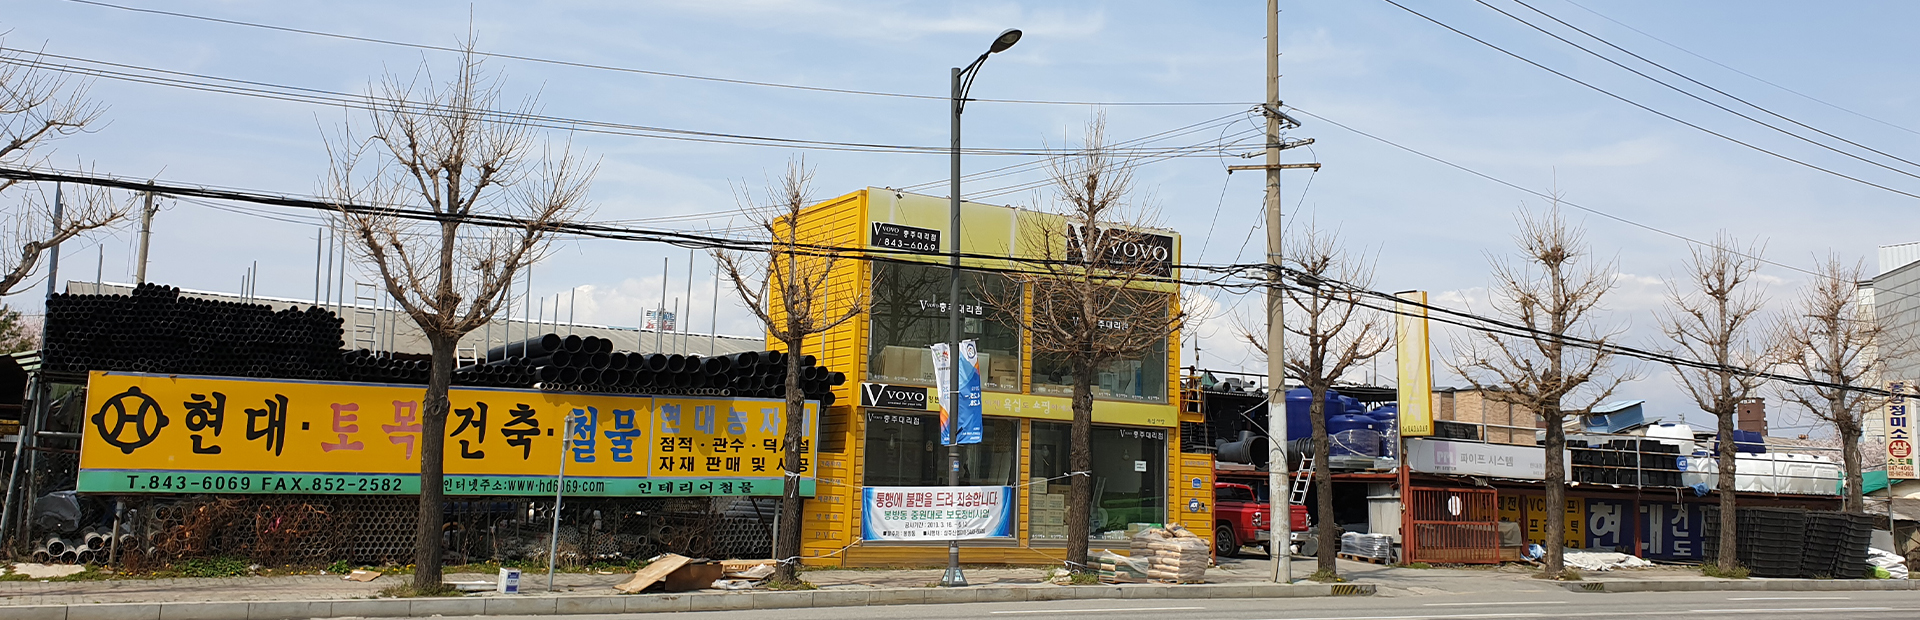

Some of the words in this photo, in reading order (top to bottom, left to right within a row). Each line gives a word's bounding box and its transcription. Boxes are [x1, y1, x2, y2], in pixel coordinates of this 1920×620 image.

[884, 238, 936, 252] 843-6069
[1110, 238, 1168, 262] VOVO
[886, 390, 925, 402] VOVO
[183, 391, 289, 457] 현대
[320, 399, 423, 461] 토목
[448, 401, 541, 461] 건축
[571, 405, 642, 463] 철물
[1890, 441, 1909, 456] 쌀
[659, 455, 695, 472] 자재
[706, 455, 741, 472] 판매
[752, 456, 765, 473] 및
[1460, 453, 1487, 465] 파이프
[1488, 455, 1514, 468] 시스템
[126, 475, 251, 490] T.843-6069
[261, 477, 403, 492] FAX.852-2582
[876, 492, 904, 508] 통행에
[906, 492, 933, 508] 불편을
[936, 492, 954, 507] 드려
[884, 510, 908, 521] 봉방동
[911, 510, 943, 520] 중원대로
